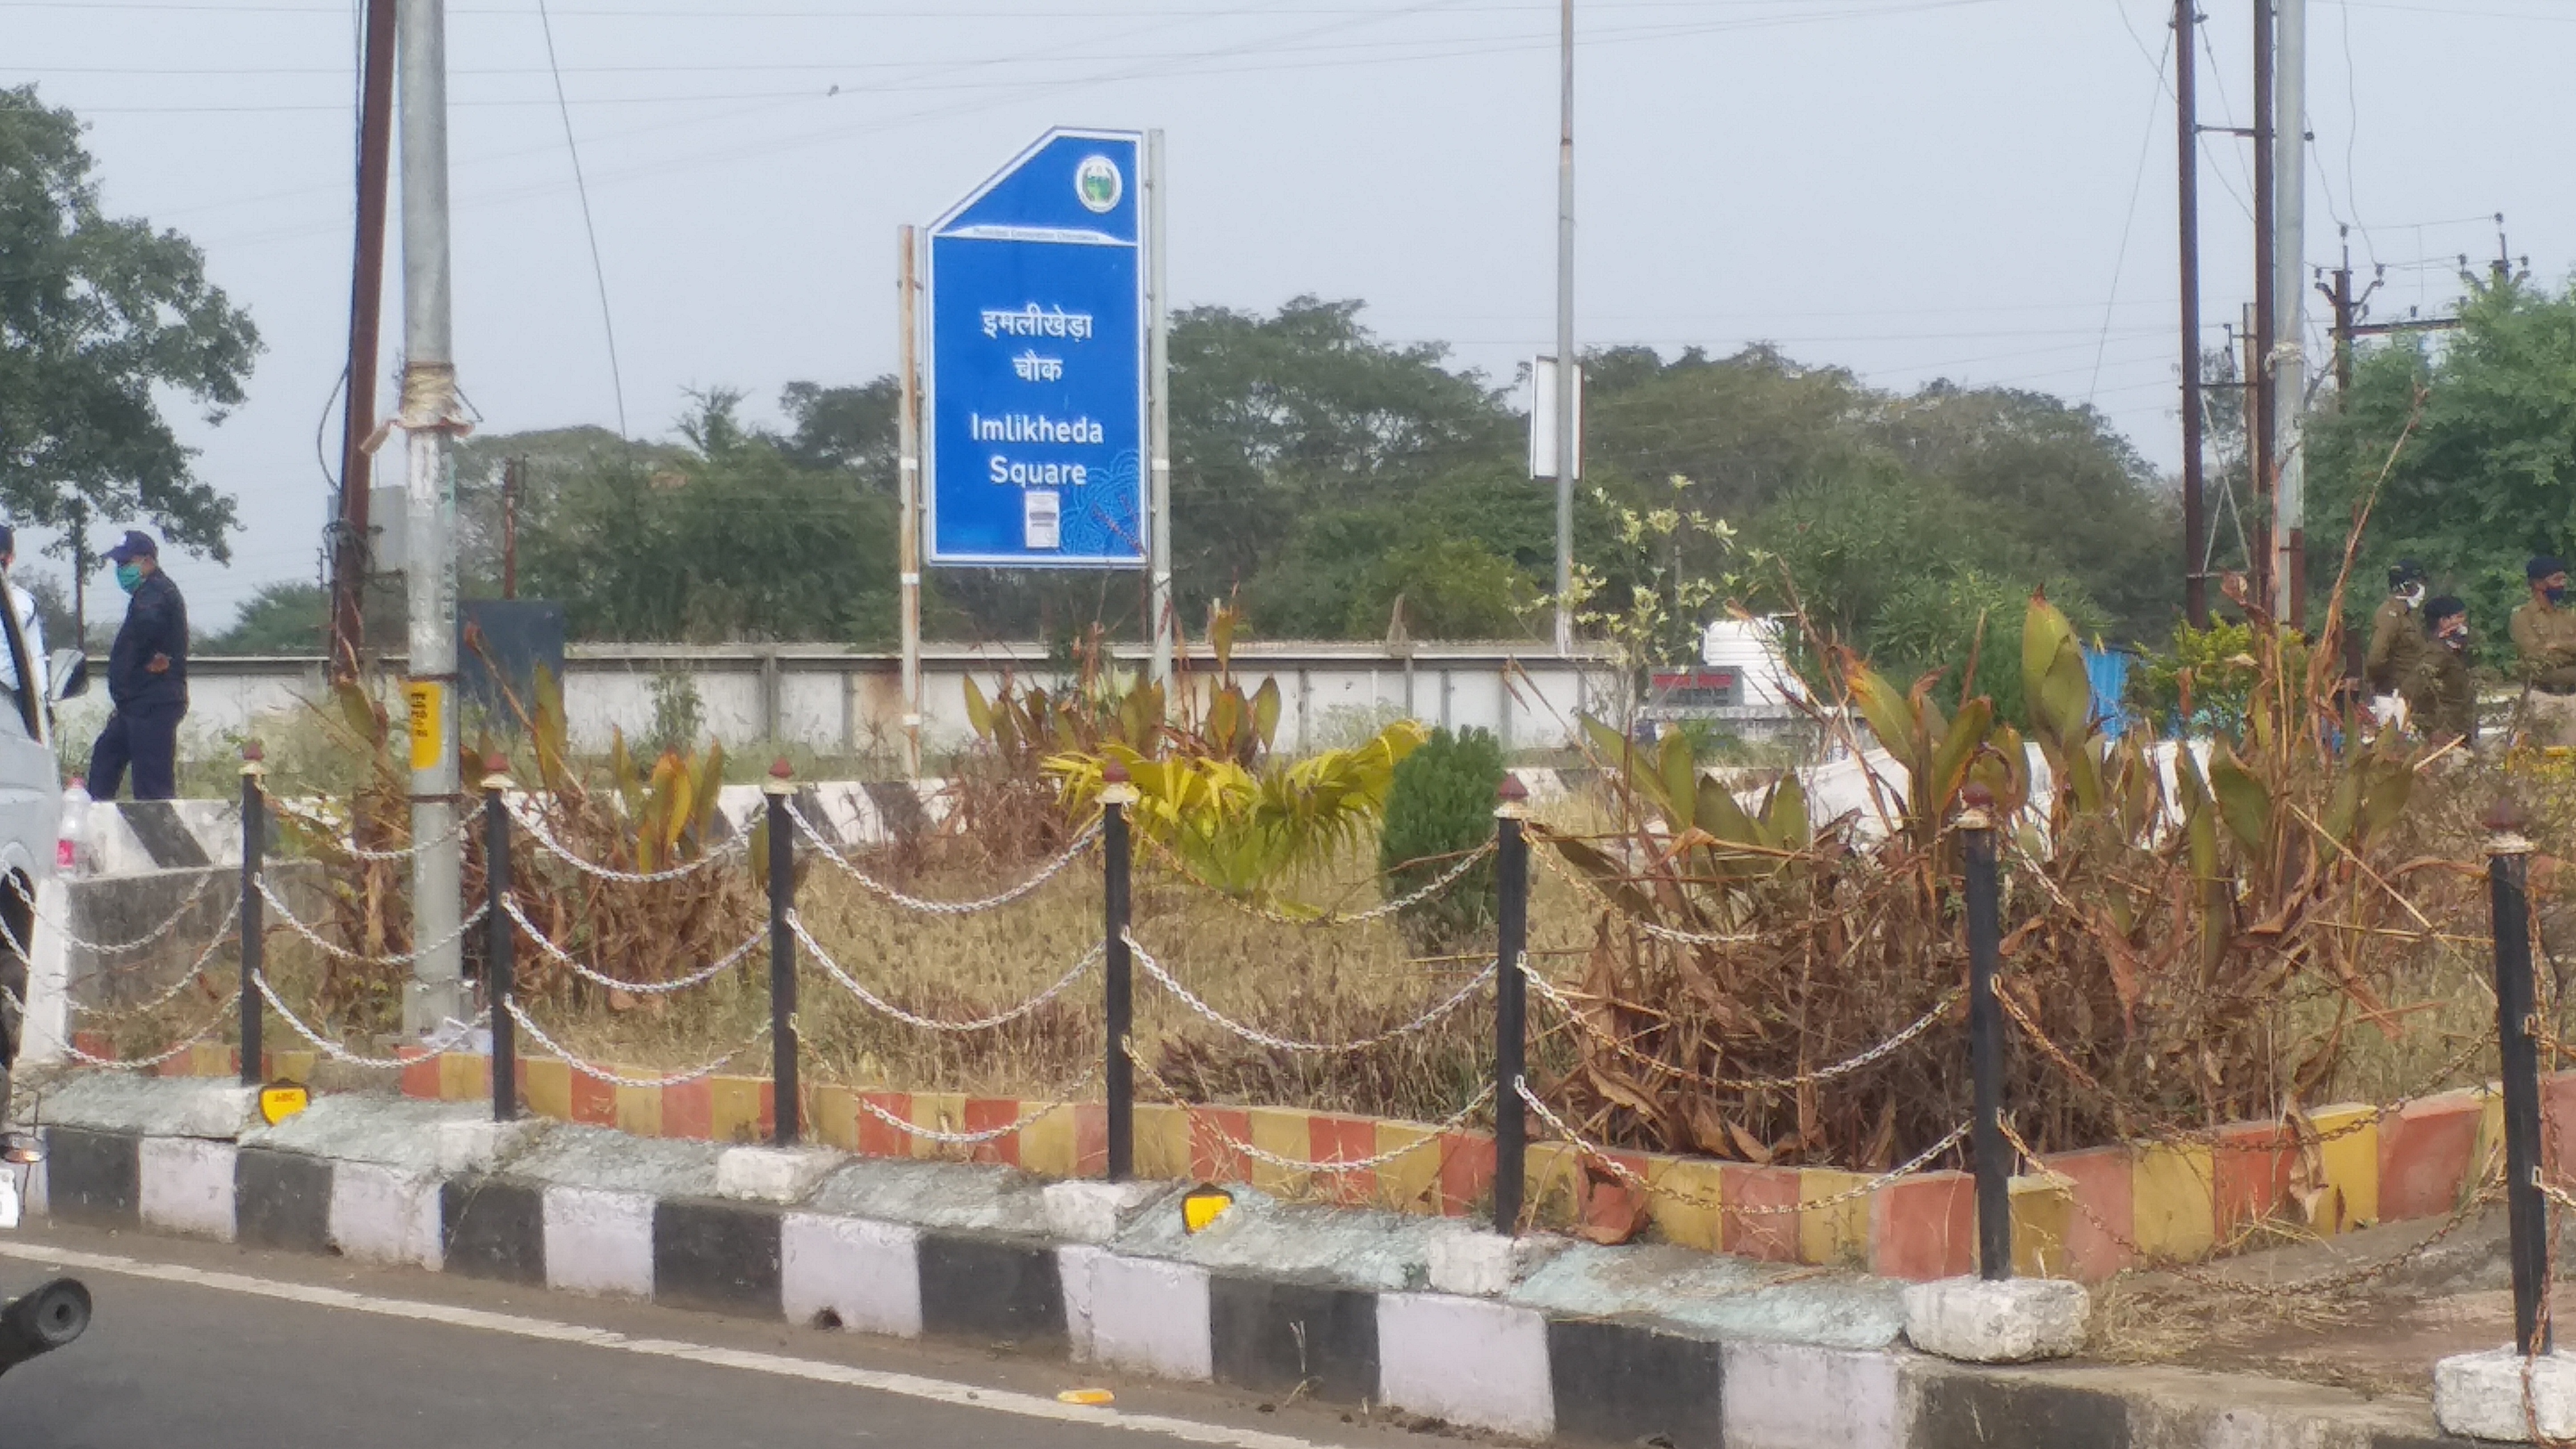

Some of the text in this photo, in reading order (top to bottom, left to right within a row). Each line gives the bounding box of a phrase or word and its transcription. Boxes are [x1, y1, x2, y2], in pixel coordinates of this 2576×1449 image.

[981, 304, 1093, 343] इमलीखेड़ा
[1012, 348, 1063, 382] चौक
[972, 413, 1104, 444] Imlikheda
[991, 455, 1087, 488] Square
